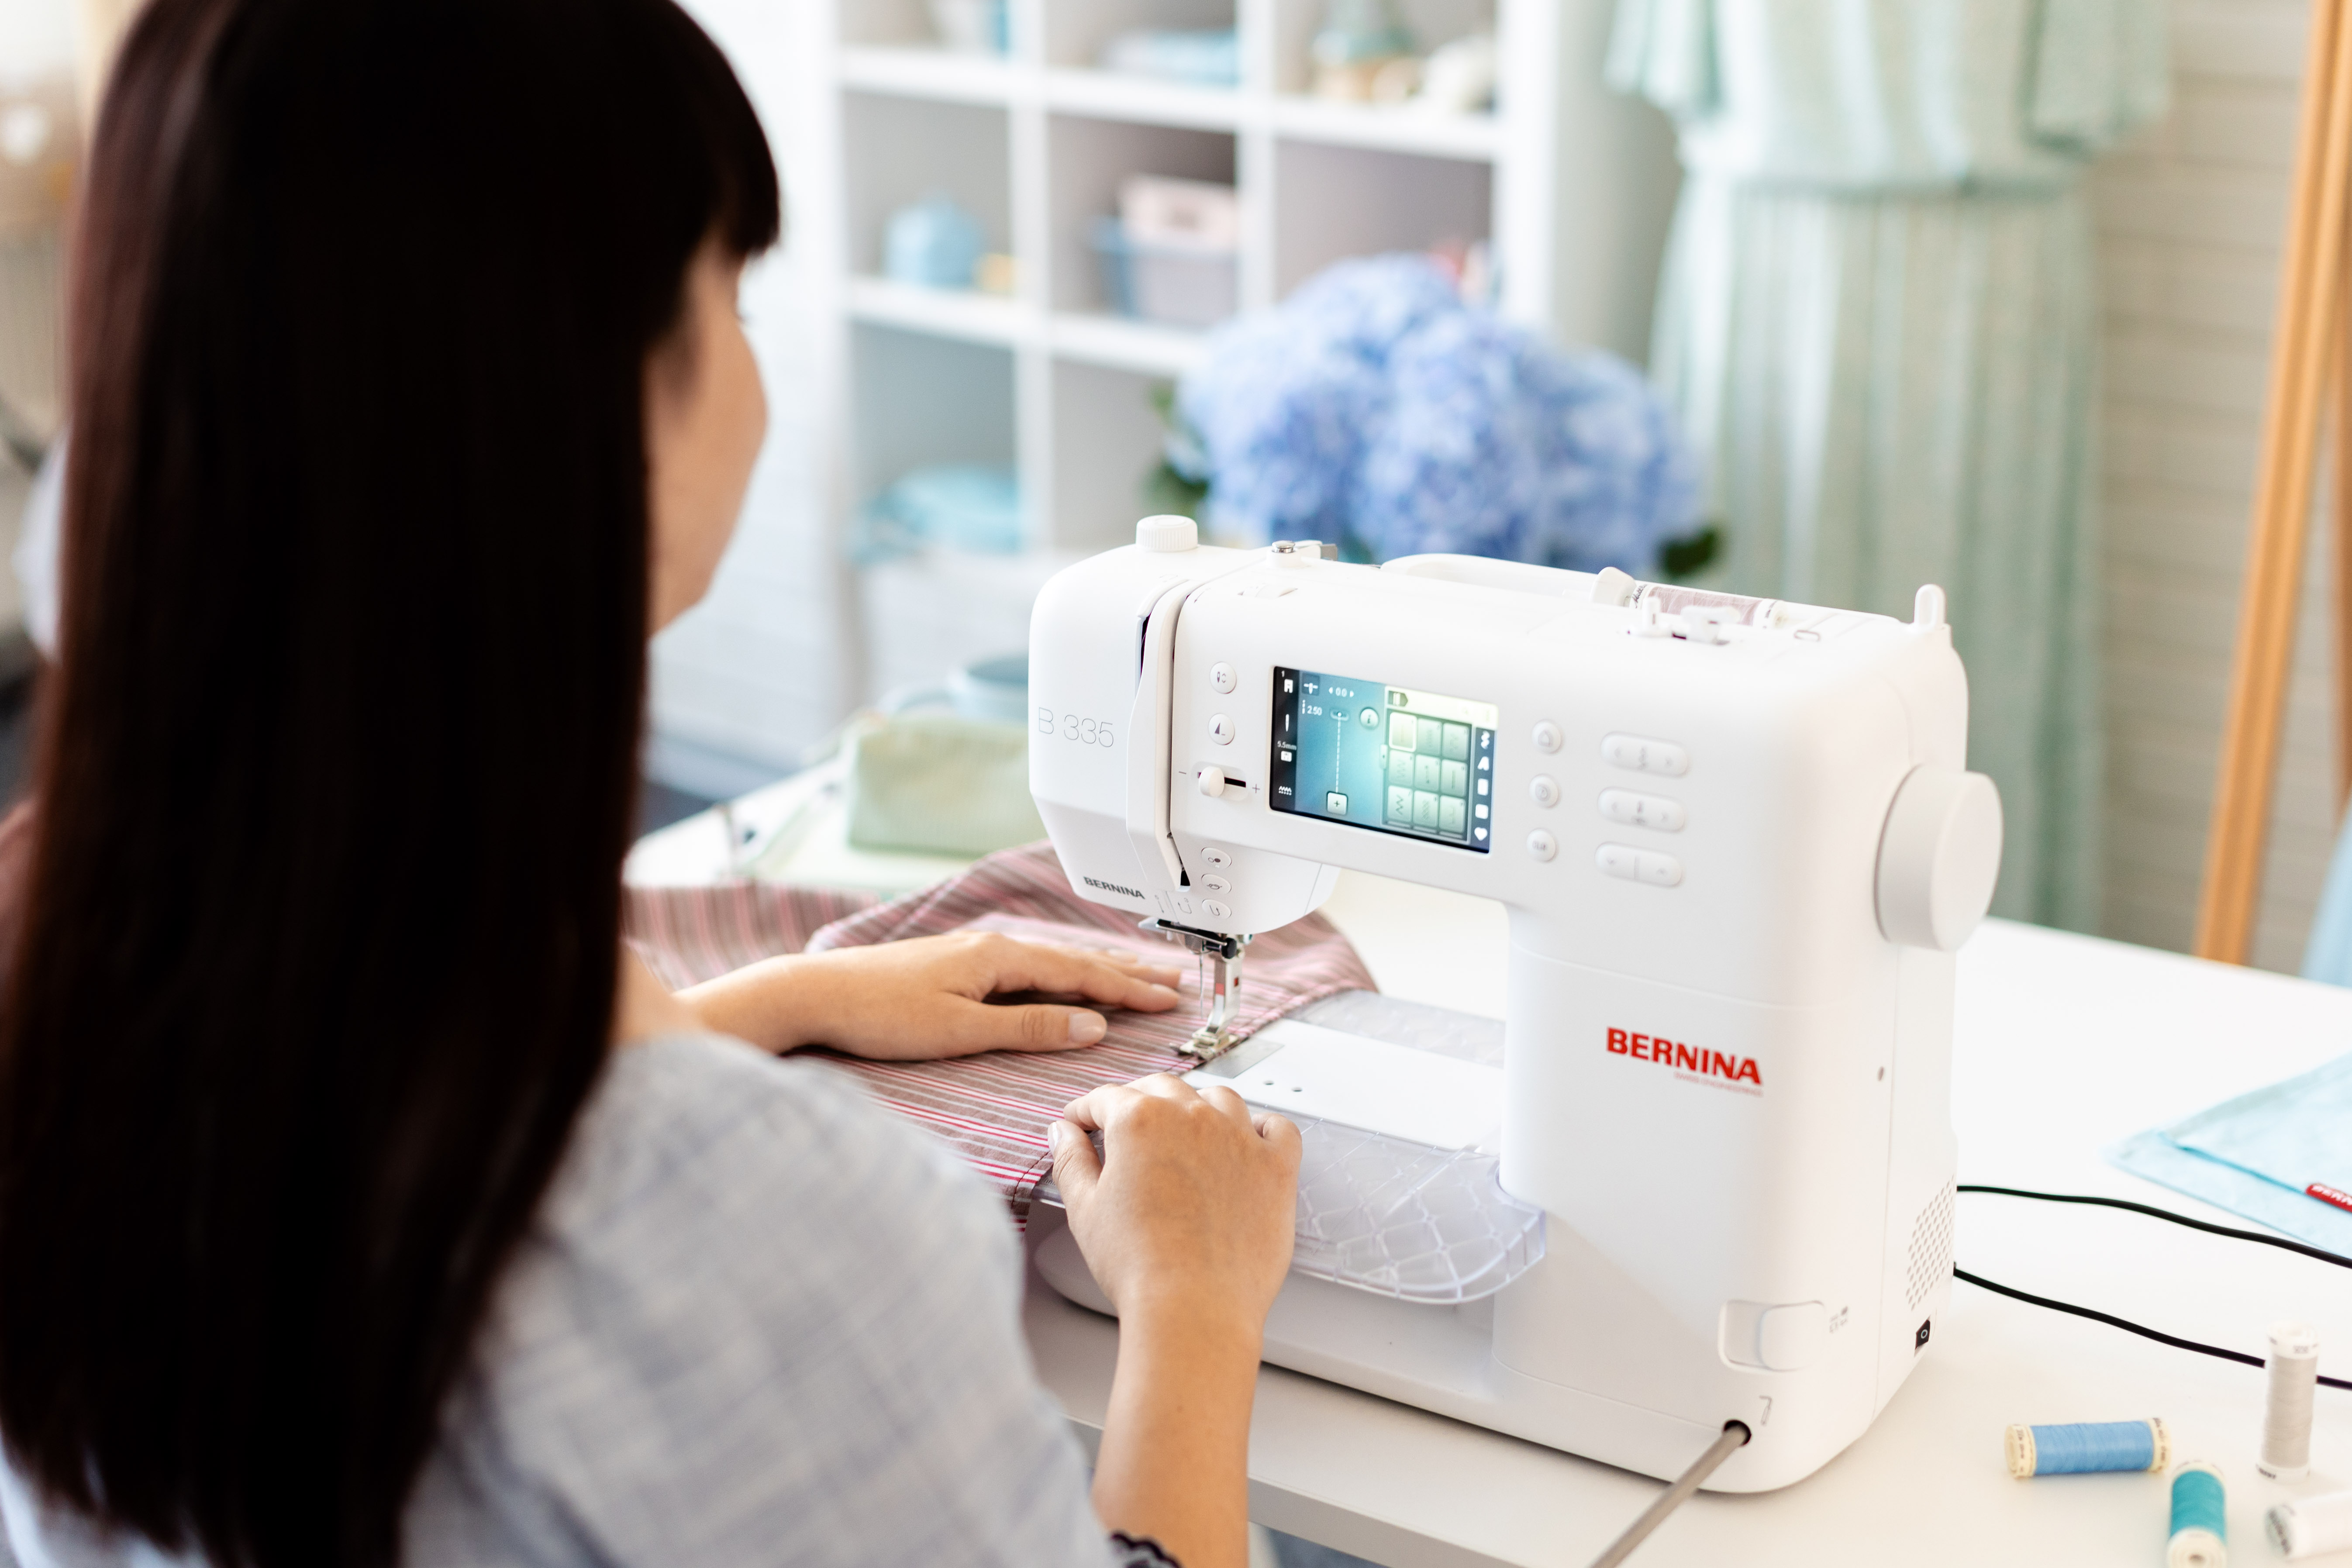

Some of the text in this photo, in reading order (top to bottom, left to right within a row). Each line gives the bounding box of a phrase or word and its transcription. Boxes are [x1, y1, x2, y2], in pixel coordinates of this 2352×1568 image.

[1038, 706, 1114, 748] B 335
[1083, 876, 1145, 899] BERNINA
[1607, 1027, 1762, 1085] BERNINA
